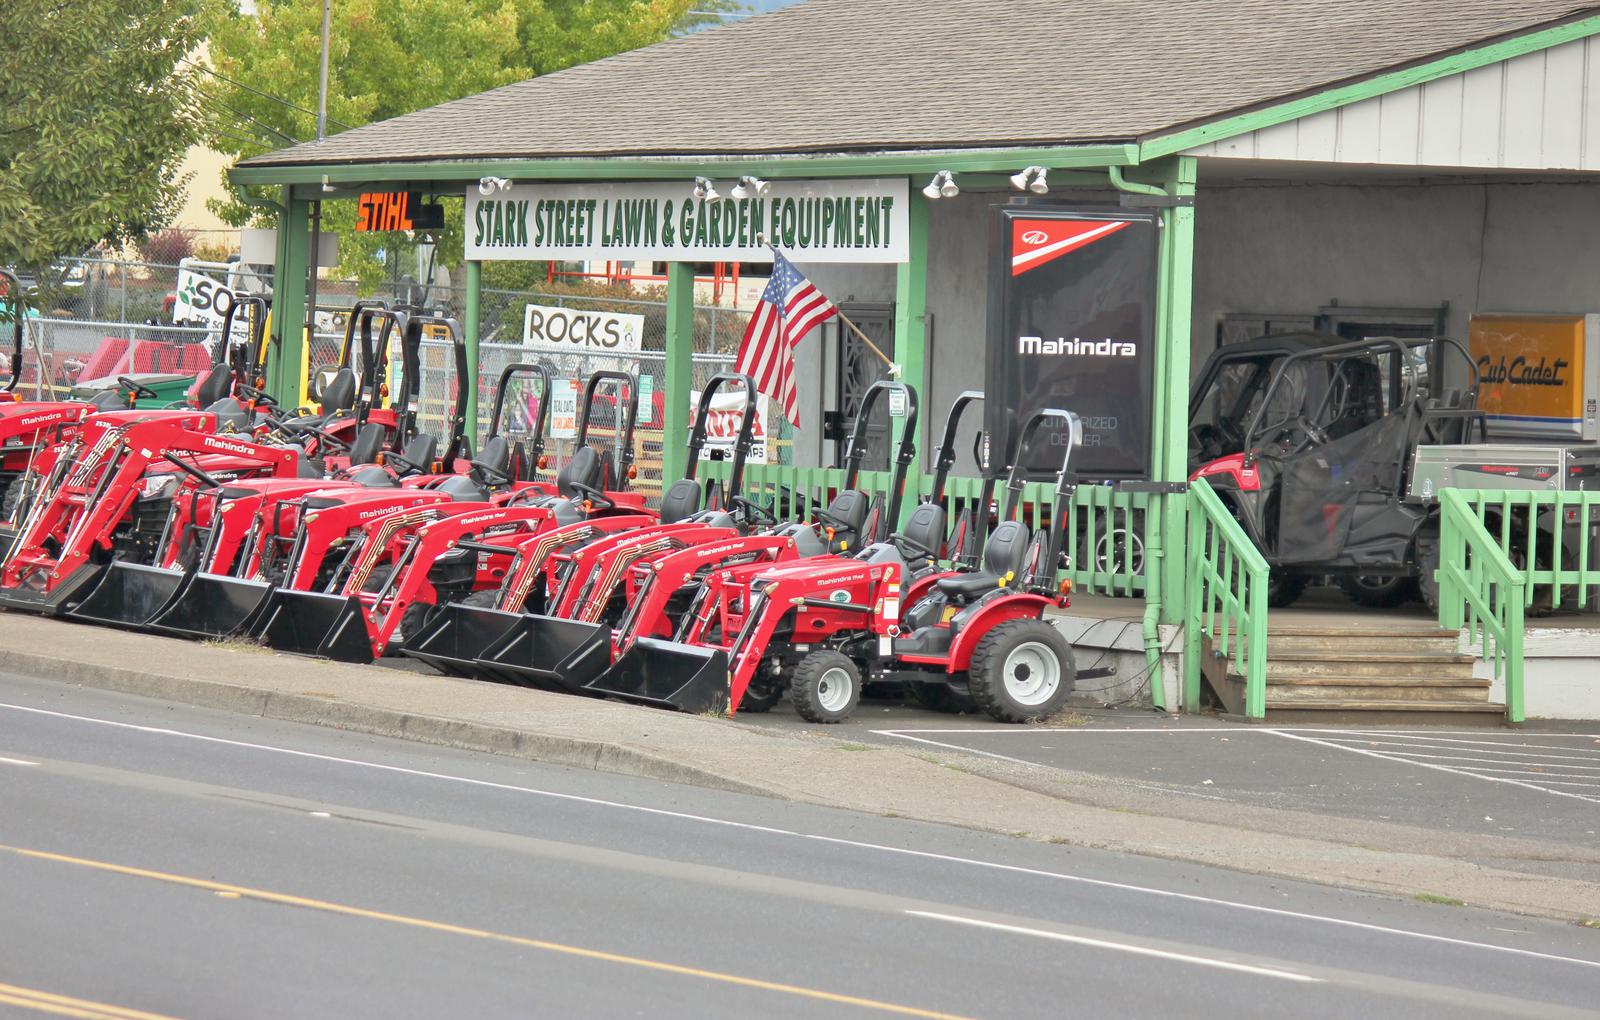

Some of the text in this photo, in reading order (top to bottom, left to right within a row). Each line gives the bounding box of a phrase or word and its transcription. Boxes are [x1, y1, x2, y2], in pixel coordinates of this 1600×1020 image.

[355, 192, 413, 231] STIHL
[475, 196, 894, 250] STARK STREET LAWN & GARDEN EQUIPMENT
[530, 310, 620, 348] ROCKS
[1019, 336, 1136, 356] Mahindra
[1477, 355, 1568, 386] Cub Cadet
[21, 413, 61, 425] Mahindra
[204, 437, 255, 455] Mahindra
[1051, 433, 1101, 447] DEER
[360, 505, 404, 519] Mahindra
[461, 514, 494, 525] Mahindra
[616, 533, 650, 546] Mahindra
[697, 545, 732, 557] Mahindra
[817, 576, 852, 586] Mahindra
